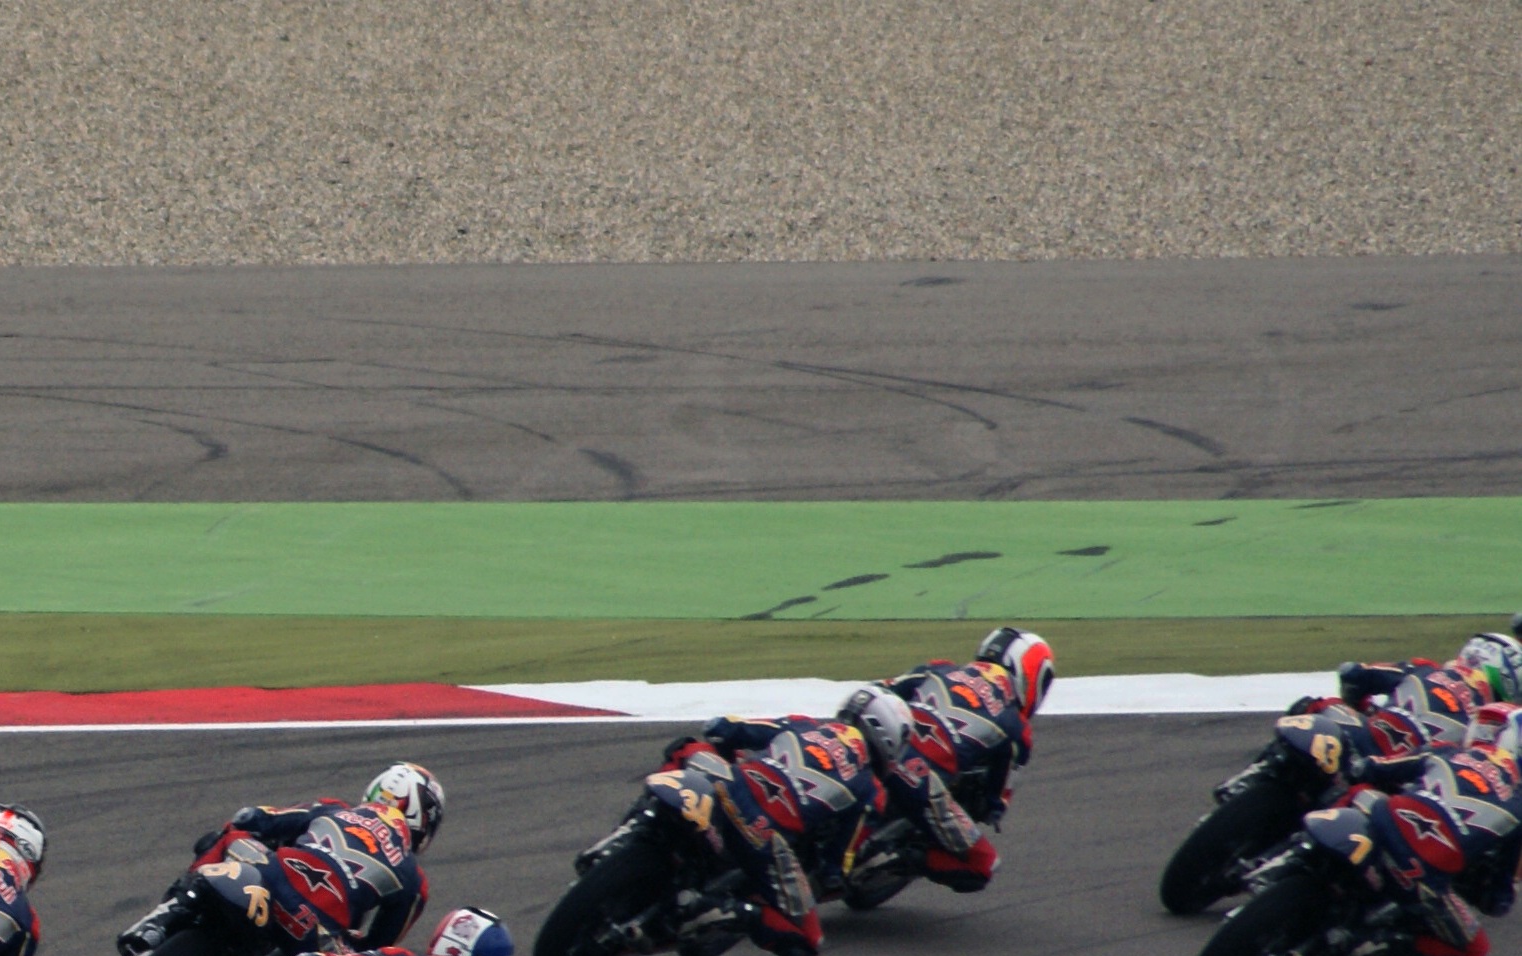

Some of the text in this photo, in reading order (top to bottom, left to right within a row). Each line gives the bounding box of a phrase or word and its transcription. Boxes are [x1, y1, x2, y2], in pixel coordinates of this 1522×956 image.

[334, 811, 378, 832] Red
[1348, 833, 1373, 865] 7
[243, 885, 271, 927] 75
